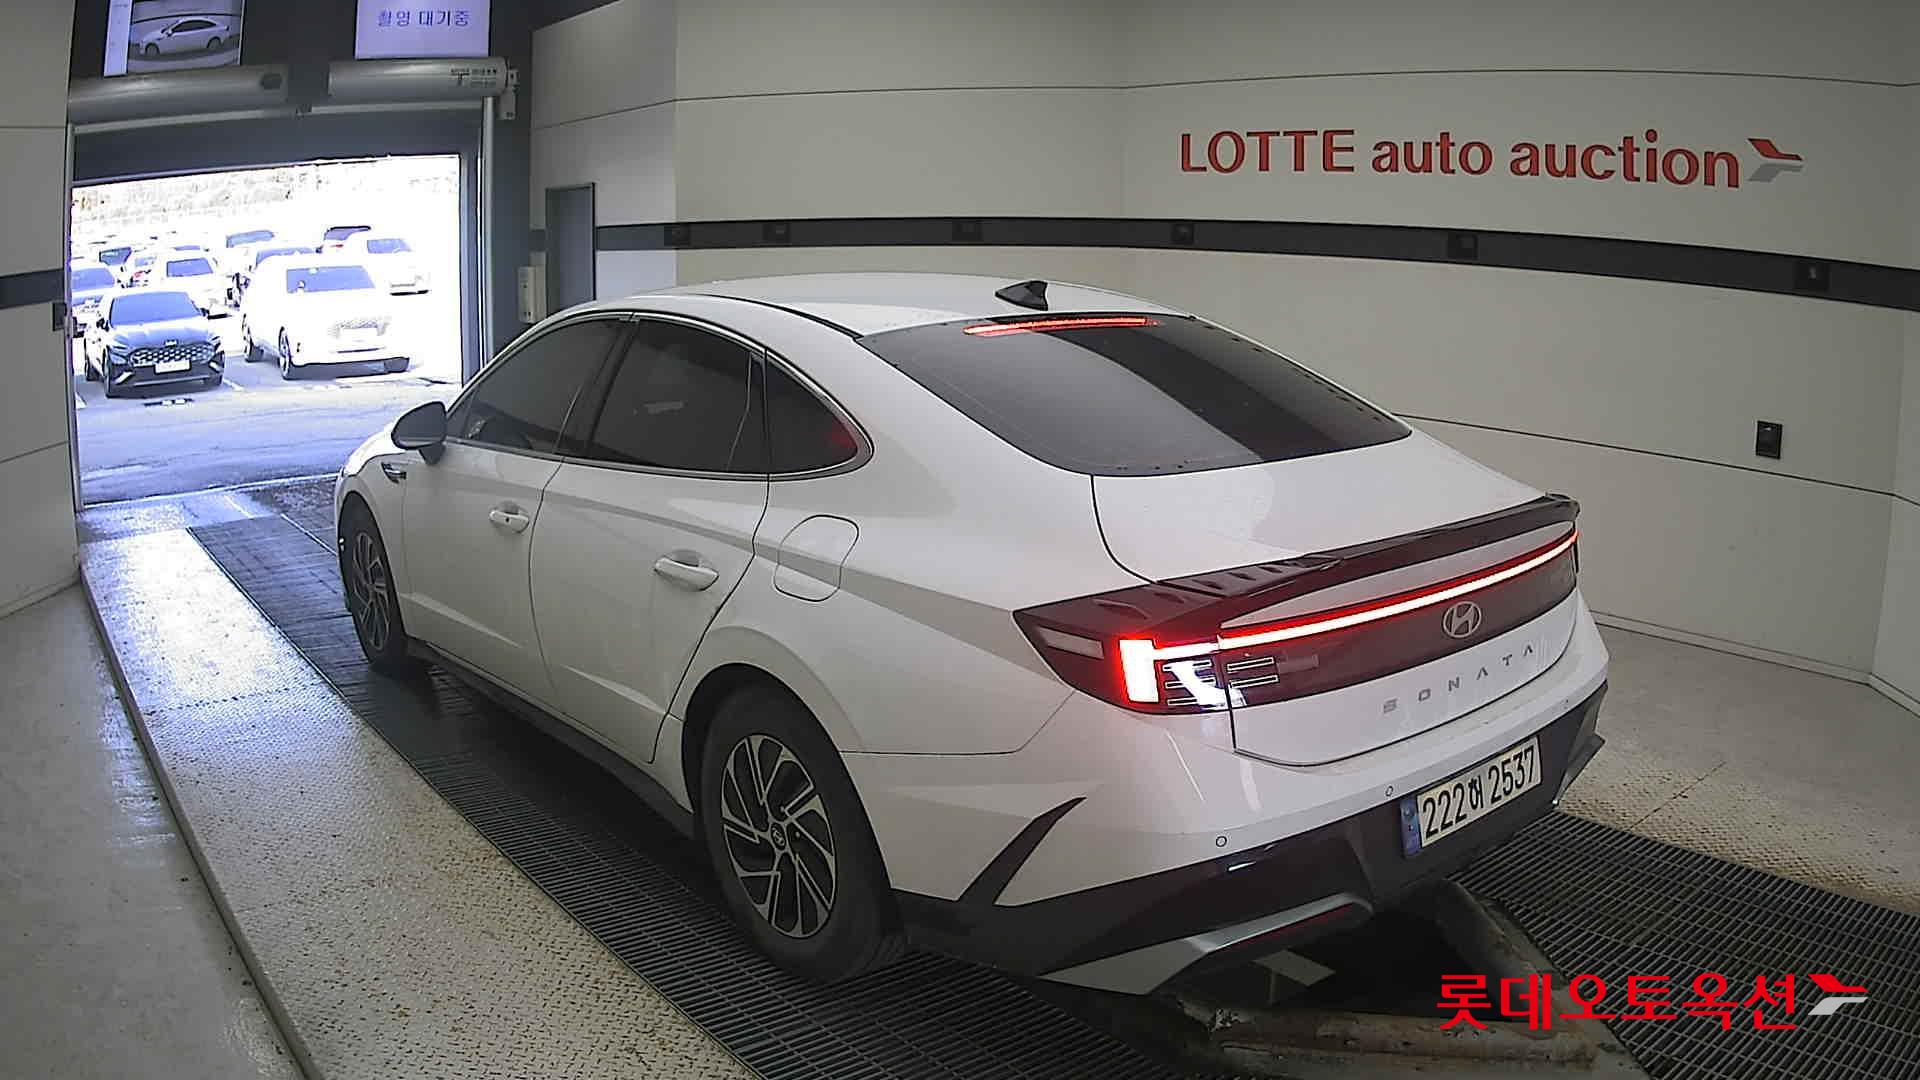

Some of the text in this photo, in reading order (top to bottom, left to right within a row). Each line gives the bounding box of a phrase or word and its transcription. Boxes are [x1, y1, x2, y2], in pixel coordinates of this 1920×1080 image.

[418, 9, 469, 27] 대기중
[1181, 129, 1740, 189] LOTTE auto auction
[1383, 644, 1533, 713] SONATA
[1488, 745, 1534, 805] 2537
